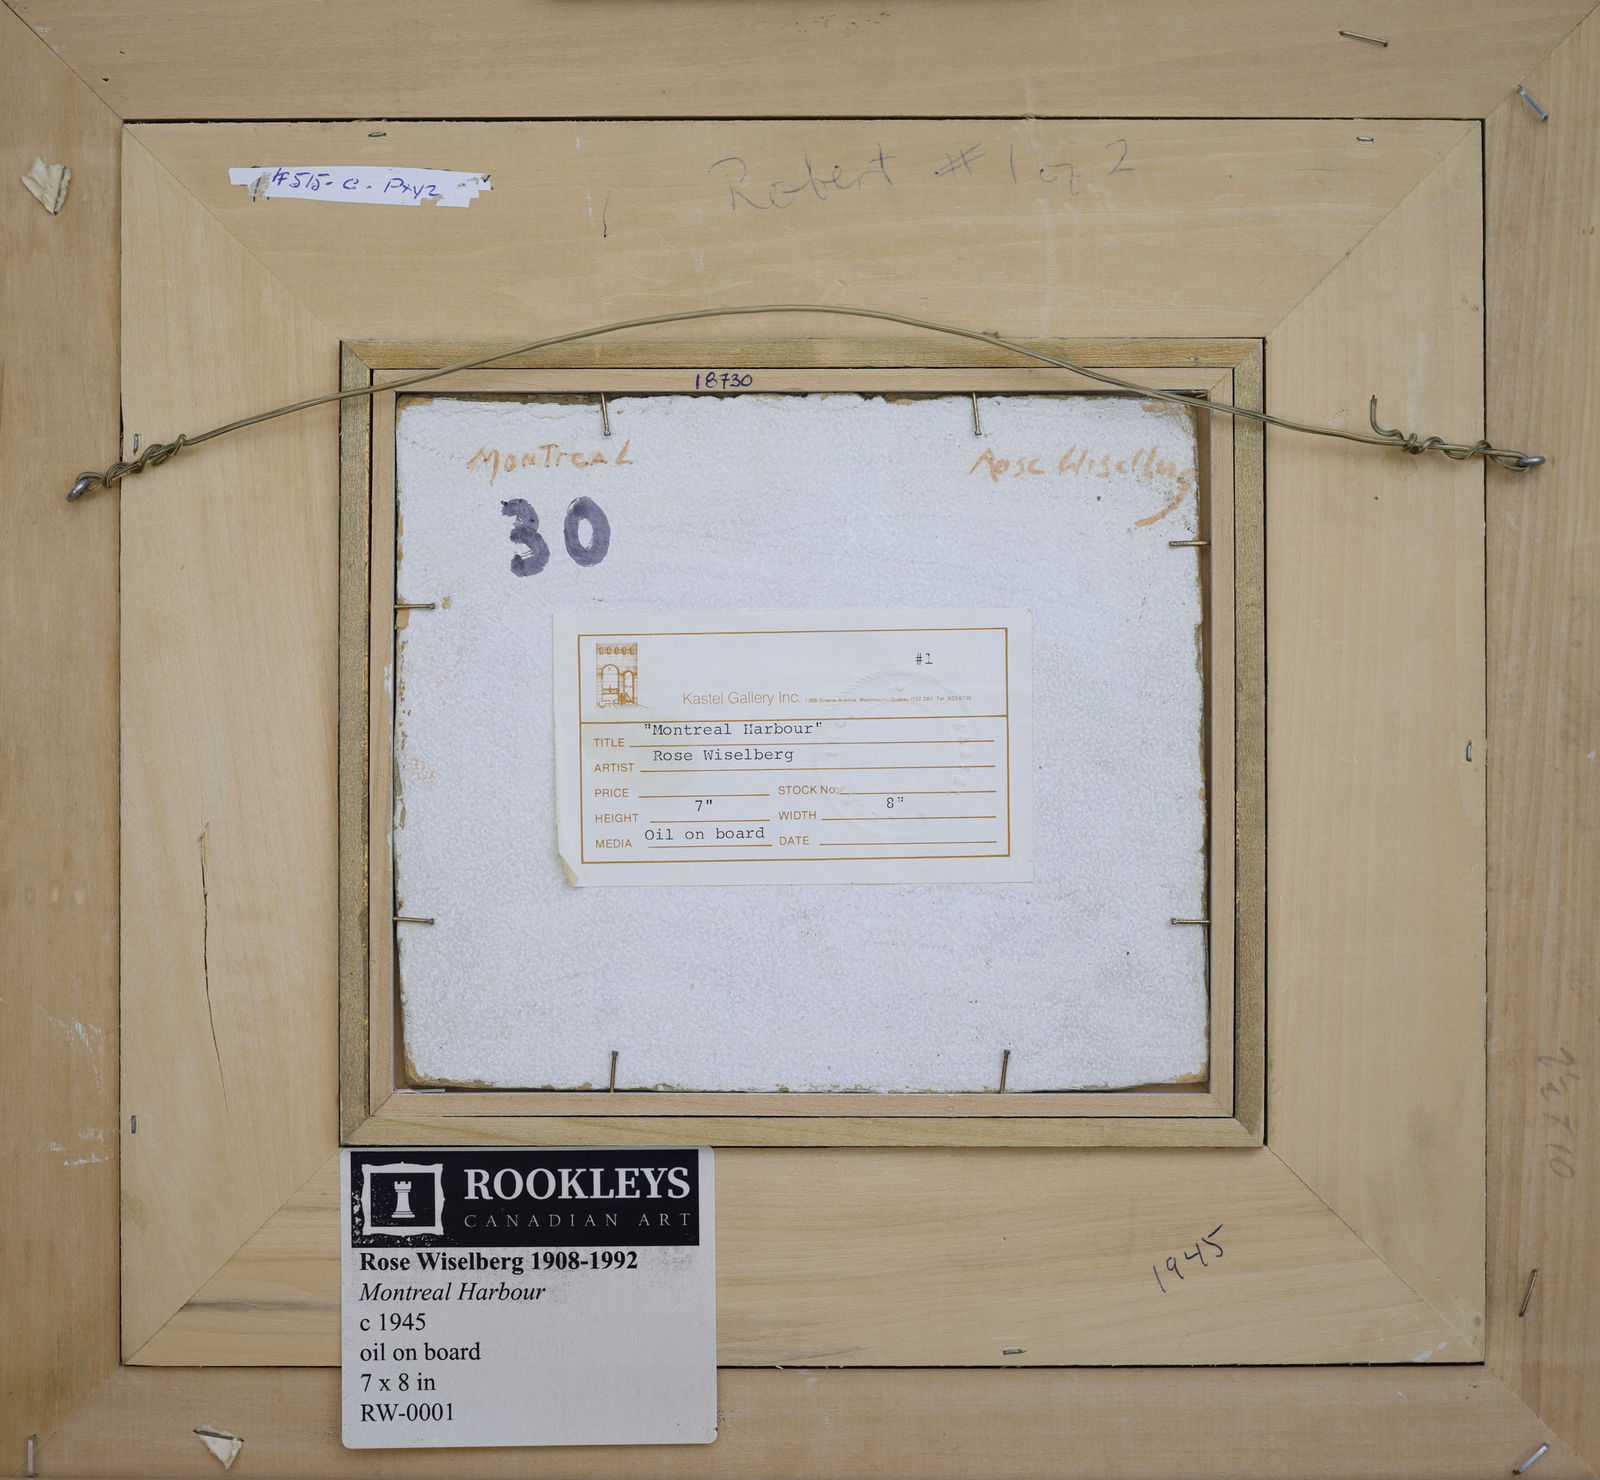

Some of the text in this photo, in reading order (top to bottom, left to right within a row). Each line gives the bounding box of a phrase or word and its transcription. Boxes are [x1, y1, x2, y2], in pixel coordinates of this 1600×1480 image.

[708, 143, 897, 210] Robert
[1105, 139, 1136, 176] 2
[695, 371, 753, 390] 18730
[500, 496, 611, 578] 30
[915, 652, 934, 666] #1
[682, 691, 801, 706] Kastel Gallery Inc.
[644, 722, 822, 735] "Montreal Harbour"
[594, 738, 624, 747] TITLE
[653, 749, 794, 763] Rose Wiselberg
[594, 763, 634, 773] ARTIST
[594, 788, 629, 798] PRICE
[778, 785, 817, 796] STOCK
[595, 813, 639, 823] HEIGHT
[778, 810, 817, 821] WIDTH
[644, 827, 765, 841] Oil on board
[779, 835, 809, 846] DATE
[595, 839, 632, 849] MEDIA
[463, 1166, 691, 1200] ROOKLEYS
[464, 1212, 692, 1228] CANADIAN ART
[359, 1250, 639, 1275] Rose Wiselberg 1908-1992
[1152, 1223, 1225, 1294] 1945
[358, 1283, 546, 1302] Montreal Harbour
[359, 1313, 427, 1332] c 1945
[359, 1342, 482, 1362] oil on board
[360, 1372, 436, 1392] 7 x 8 in
[360, 1402, 454, 1422] RW-0001
